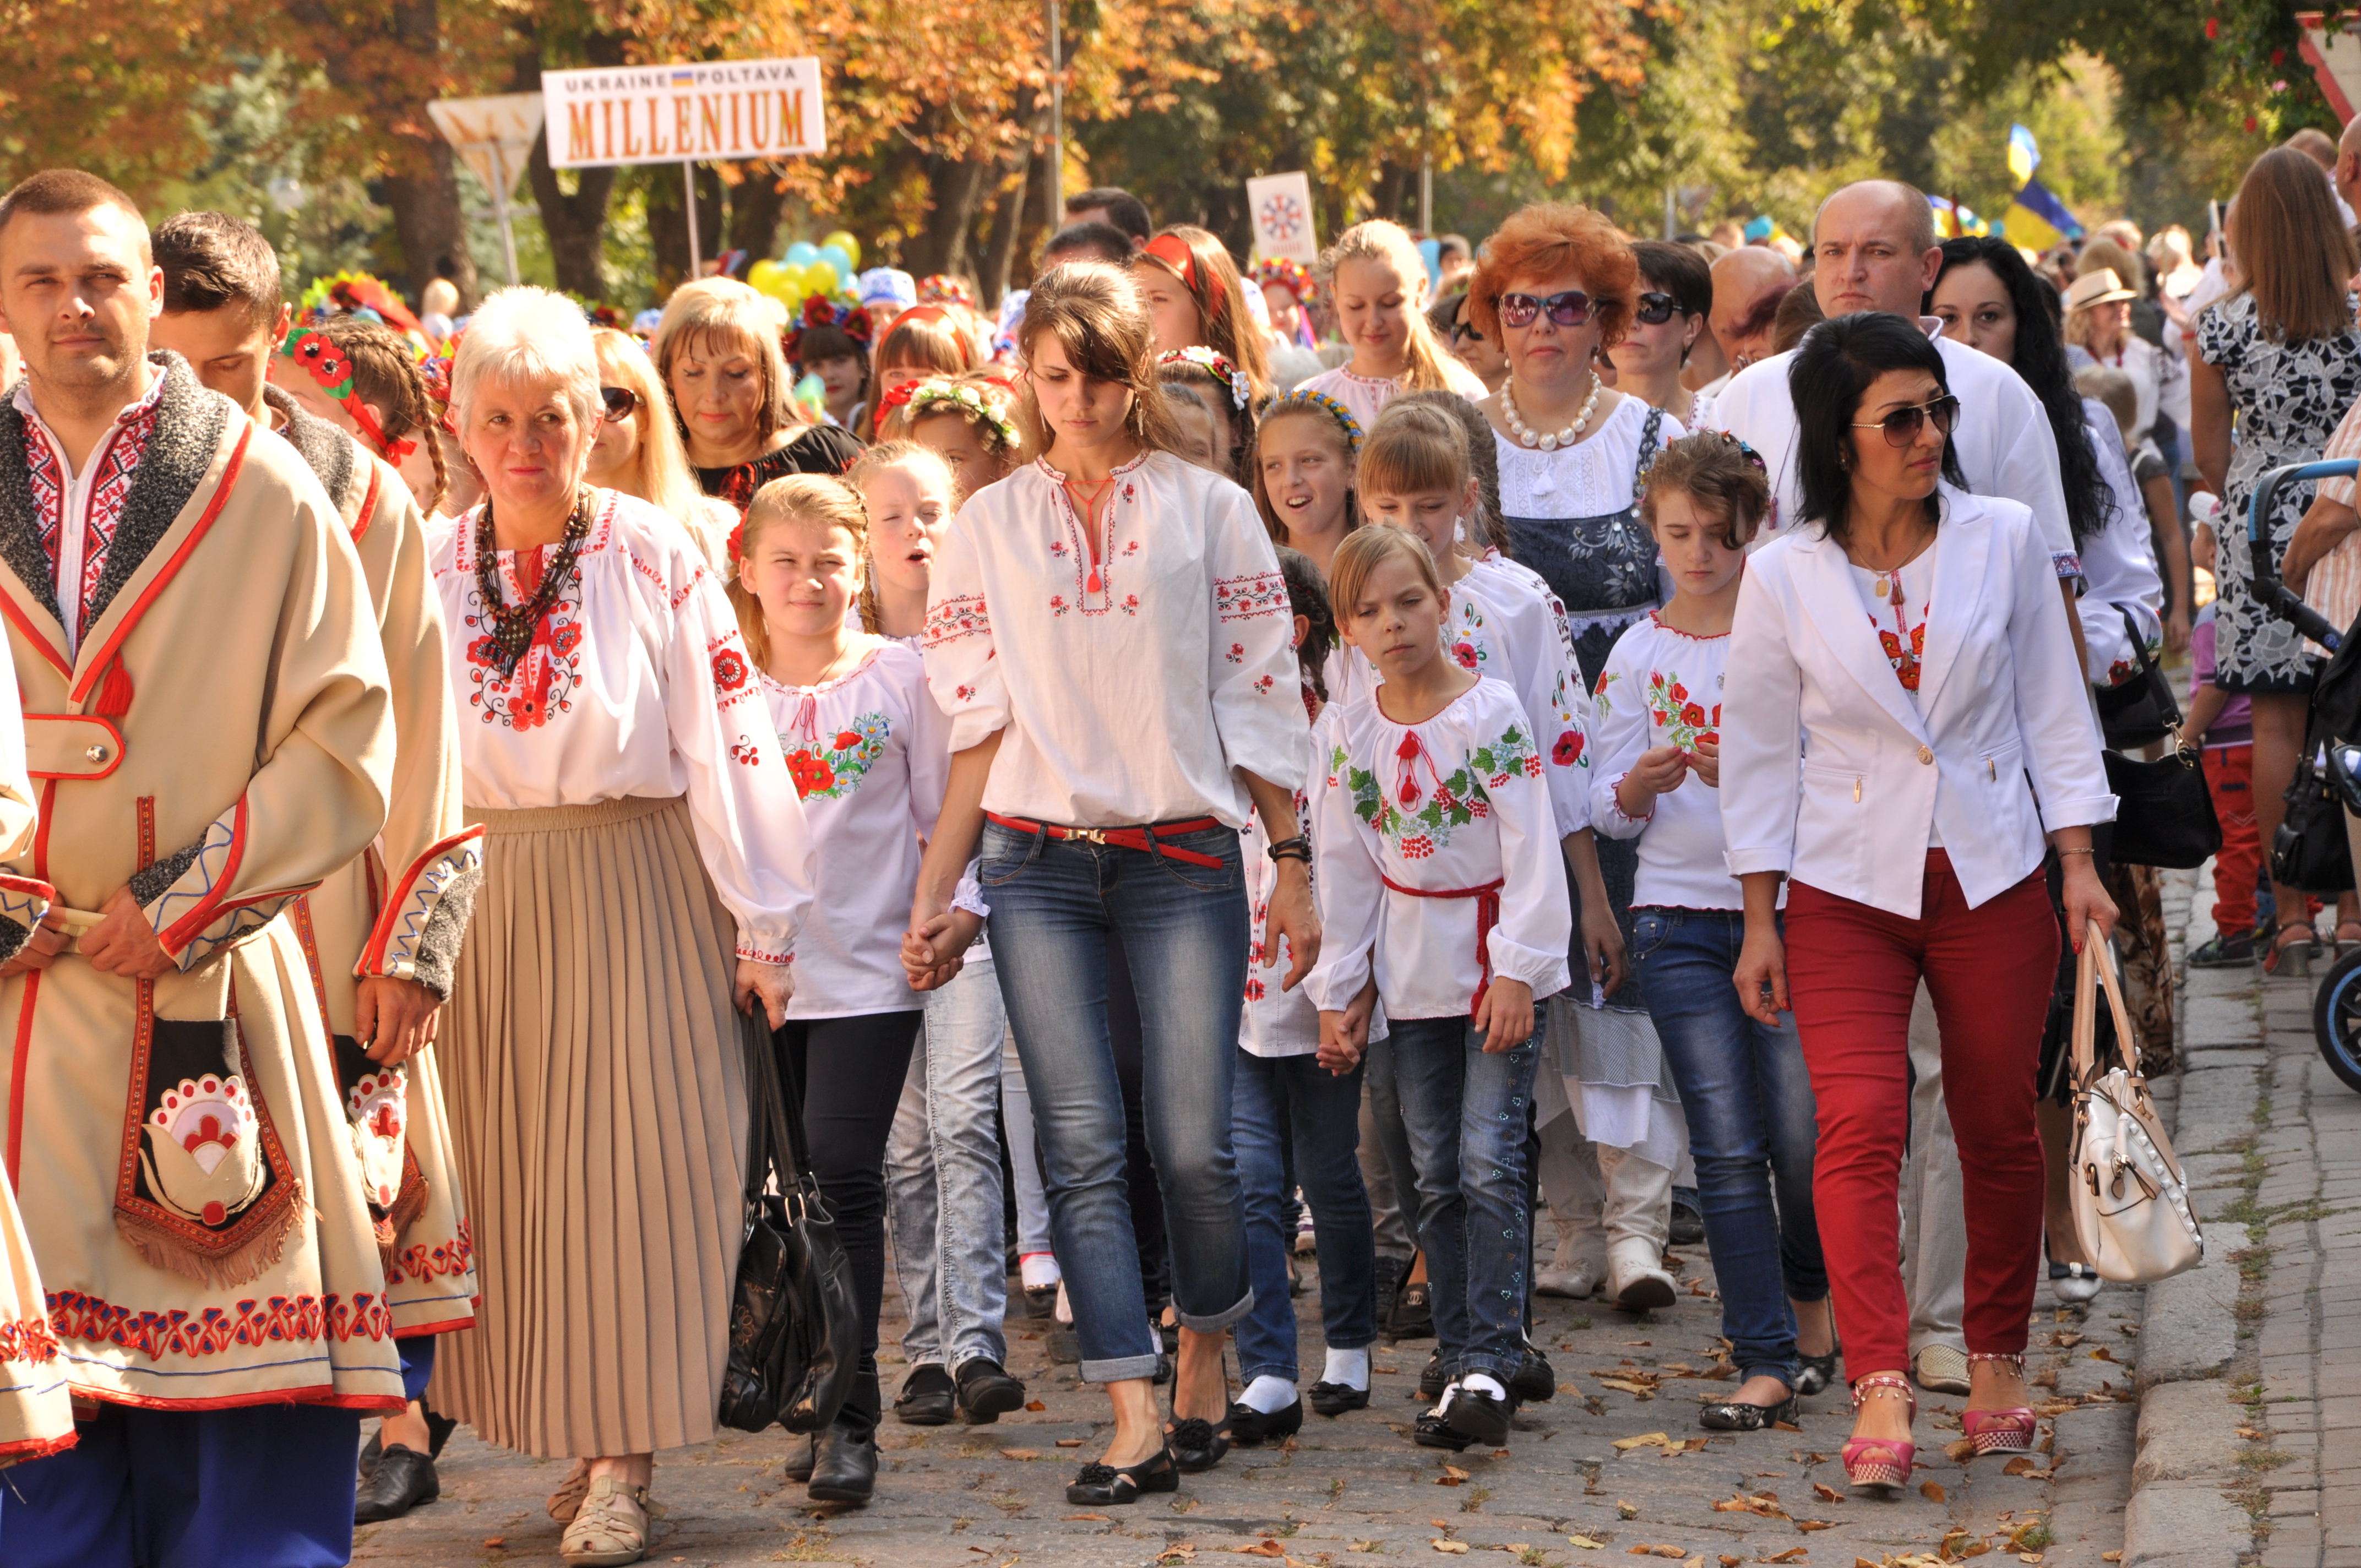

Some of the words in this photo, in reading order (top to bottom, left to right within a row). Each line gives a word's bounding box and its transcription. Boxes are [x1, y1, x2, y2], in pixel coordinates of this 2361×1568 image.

[566, 74, 666, 92] UKRAINE
[697, 66, 796, 84] POLTAVA
[567, 89, 806, 161] MILLENIUM
